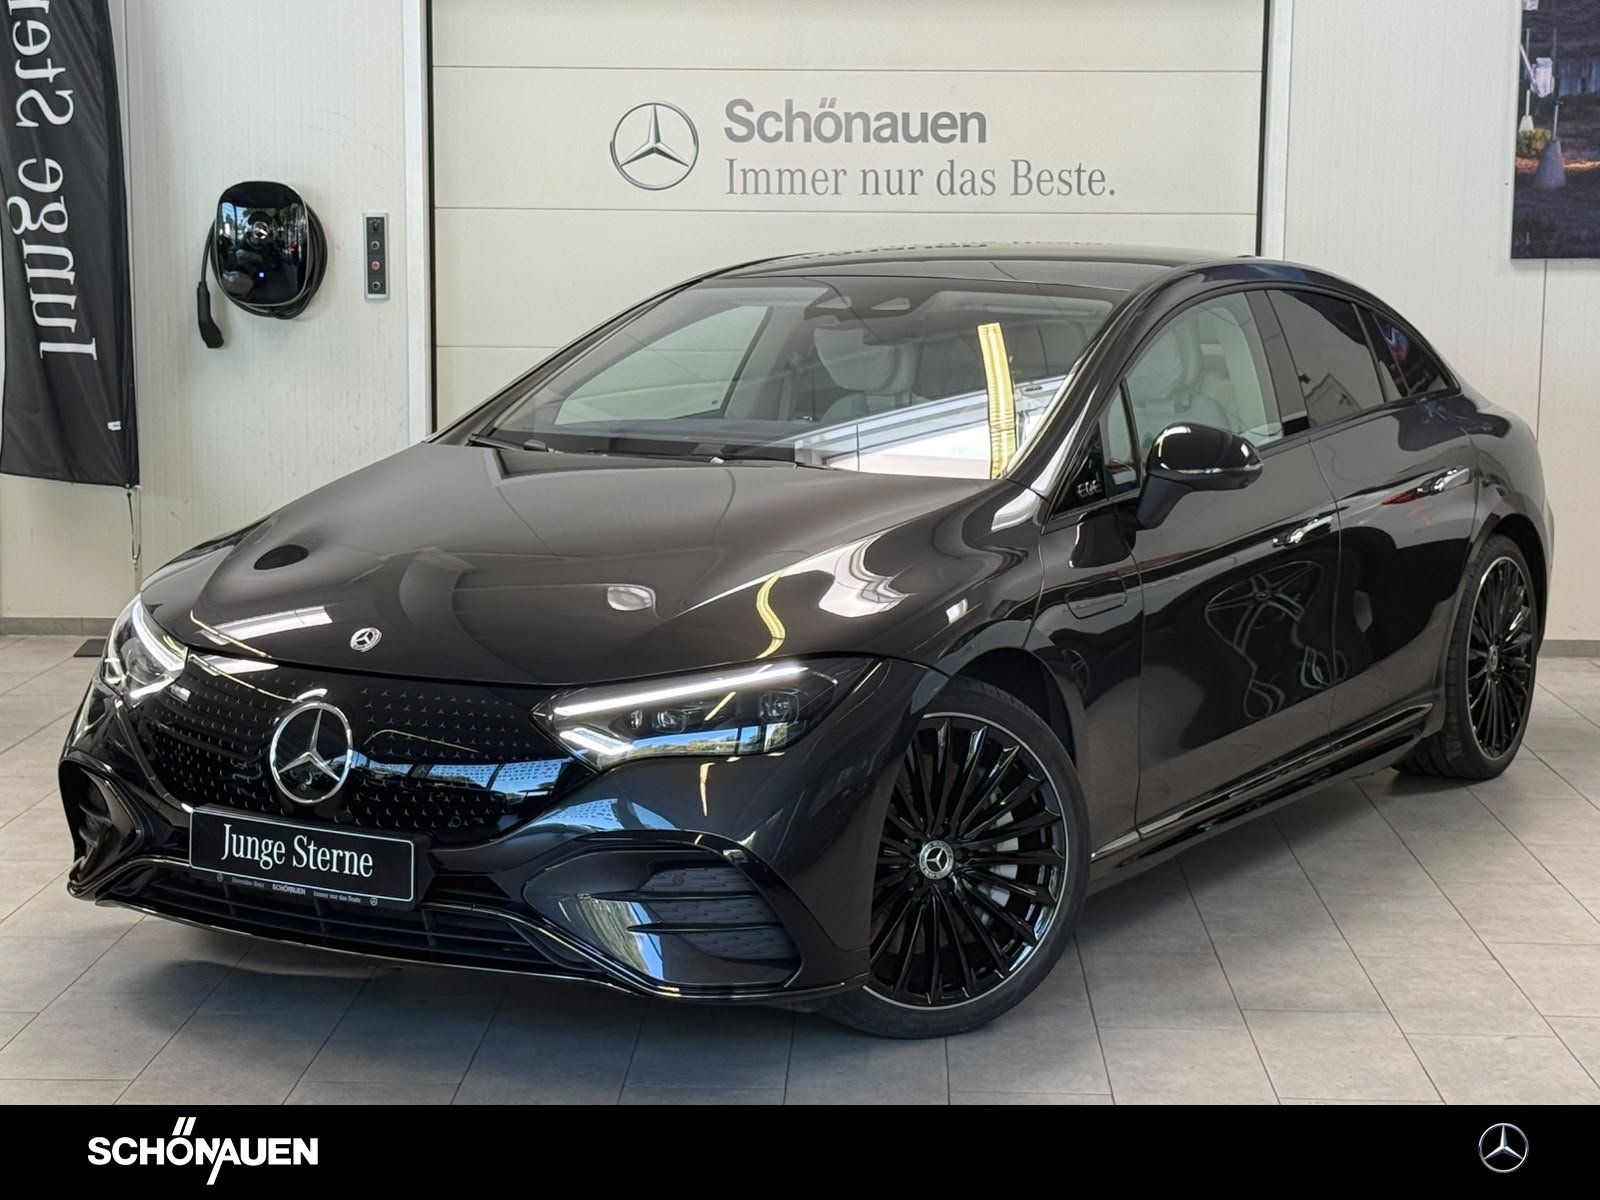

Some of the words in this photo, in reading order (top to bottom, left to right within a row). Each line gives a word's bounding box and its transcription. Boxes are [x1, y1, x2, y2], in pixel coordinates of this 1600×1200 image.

[724, 97, 987, 144] Schönauen
[725, 158, 847, 196] Immer
[860, 168, 924, 196] nur
[936, 159, 996, 197] das
[1009, 159, 1117, 197] Beste.
[221, 823, 286, 870] Junge
[292, 835, 374, 878] Sterne
